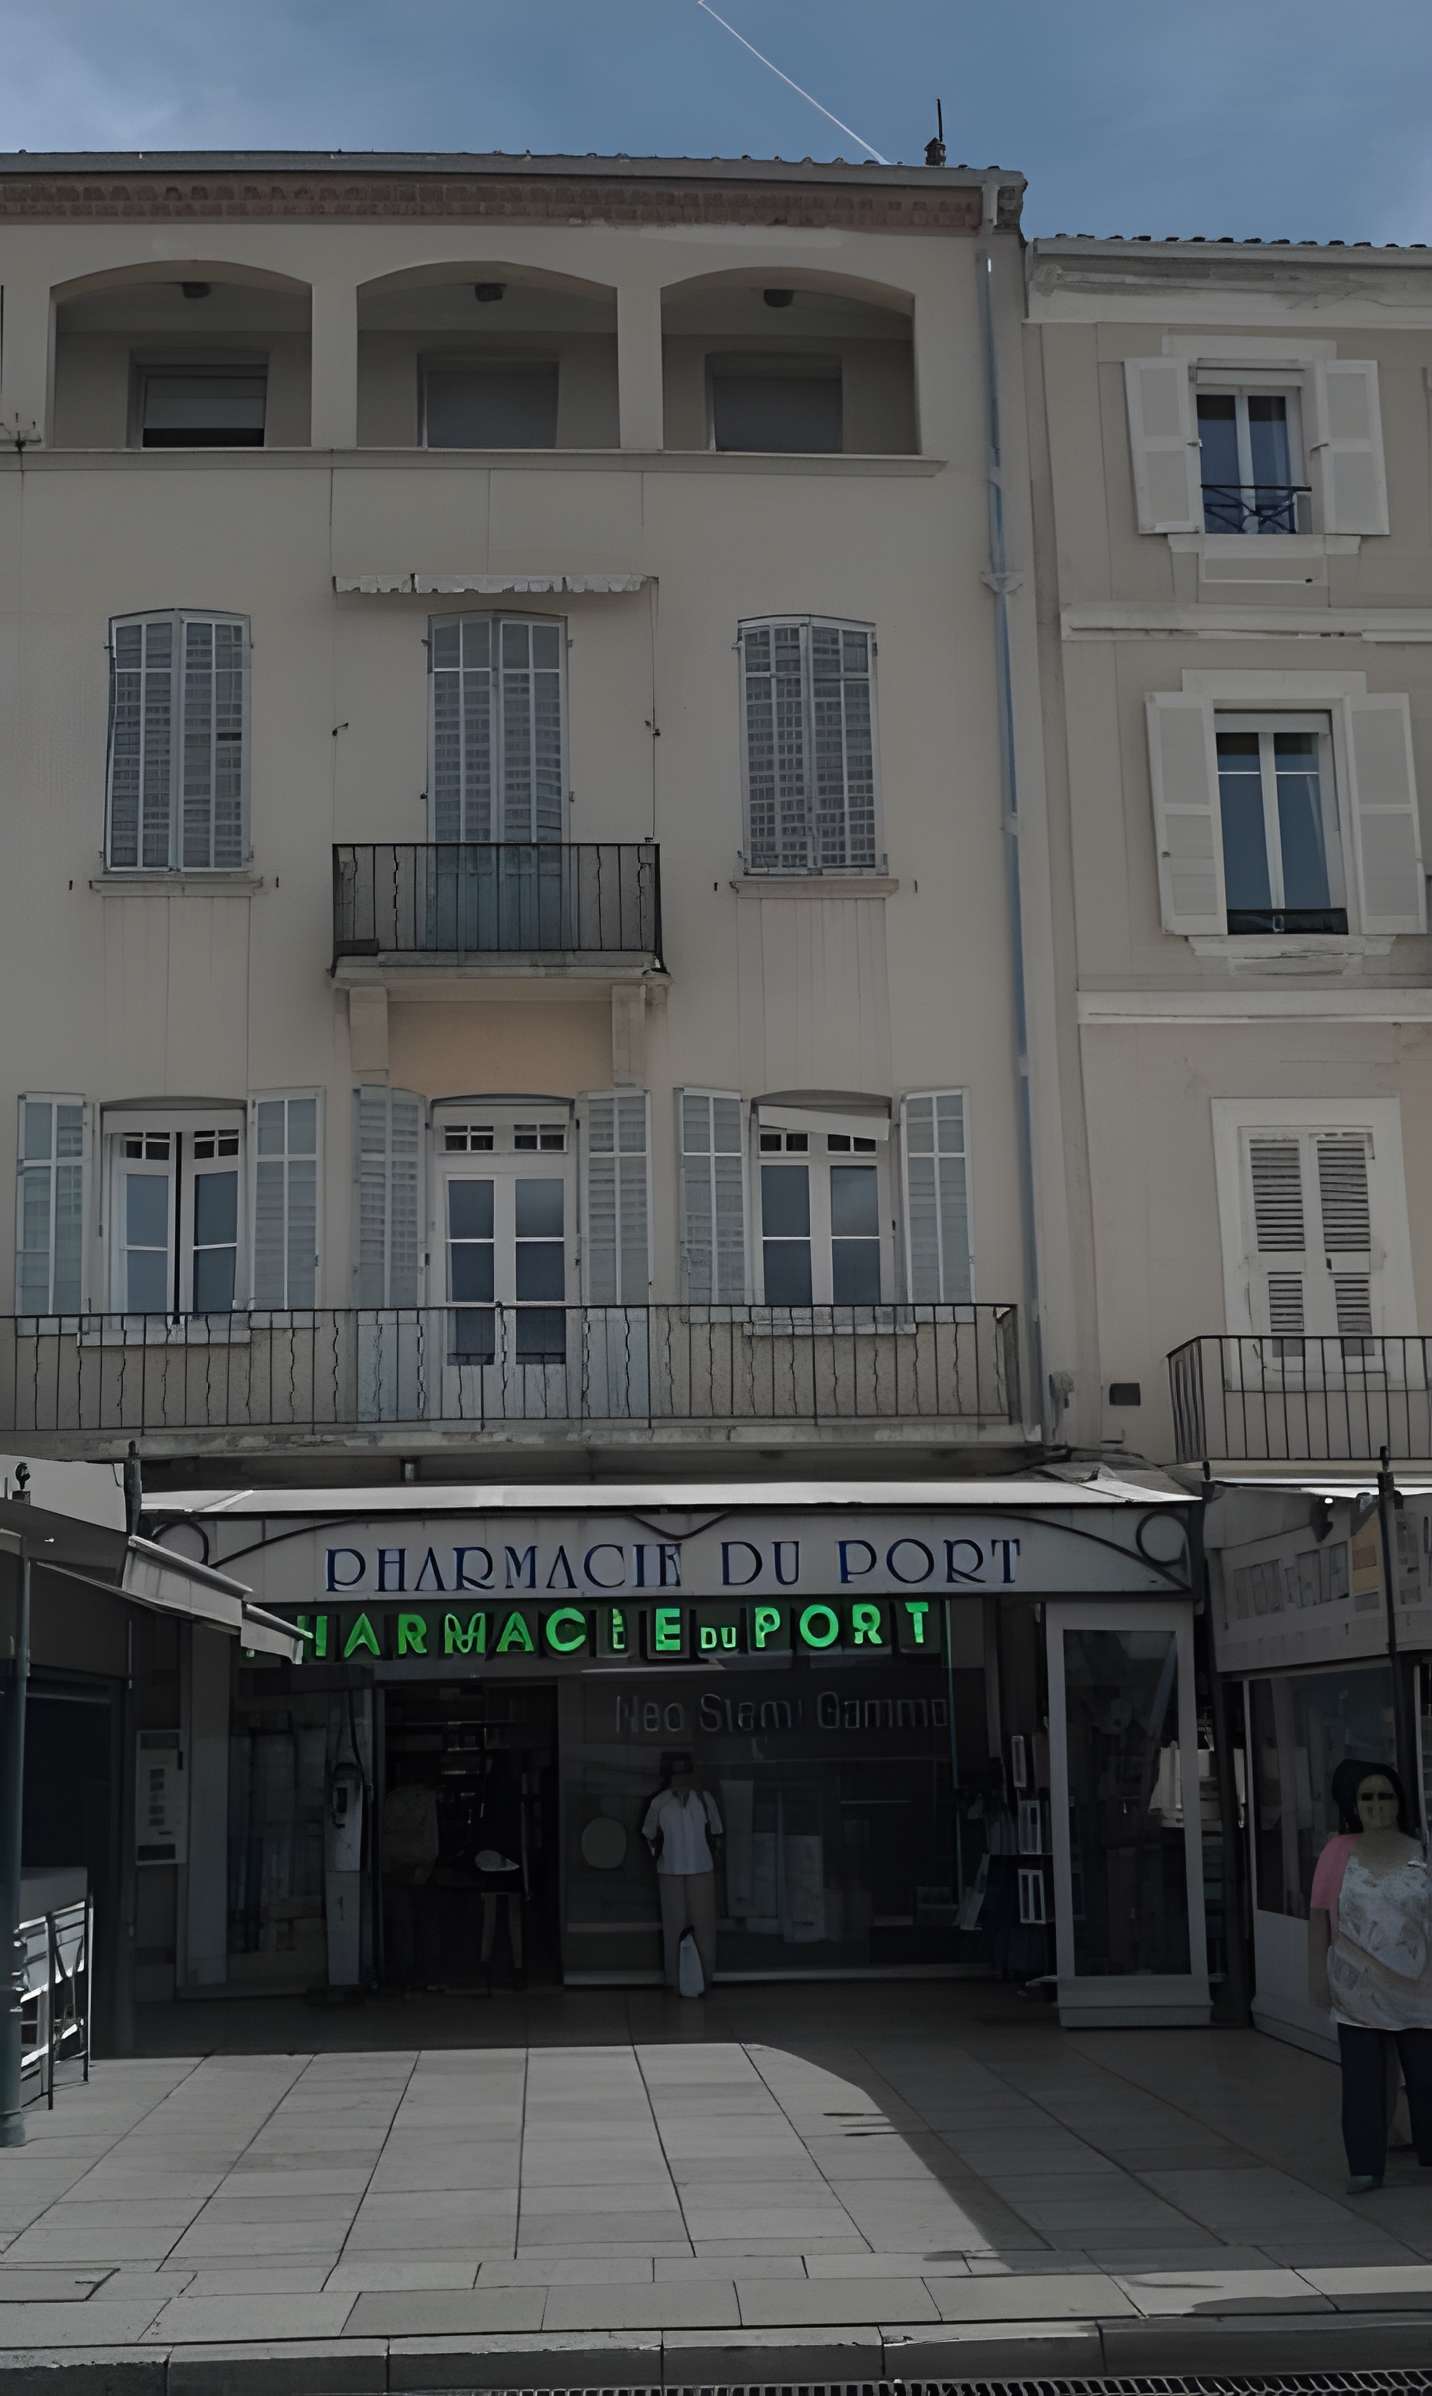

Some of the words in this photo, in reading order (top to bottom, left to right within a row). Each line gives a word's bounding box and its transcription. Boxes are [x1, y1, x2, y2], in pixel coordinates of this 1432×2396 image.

[326, 1543, 682, 1593] PHARMACIE
[720, 1541, 801, 1587] DU
[837, 1537, 1022, 1585] PORT
[700, 1626, 738, 1650] DU
[754, 1602, 930, 1649] PORT
